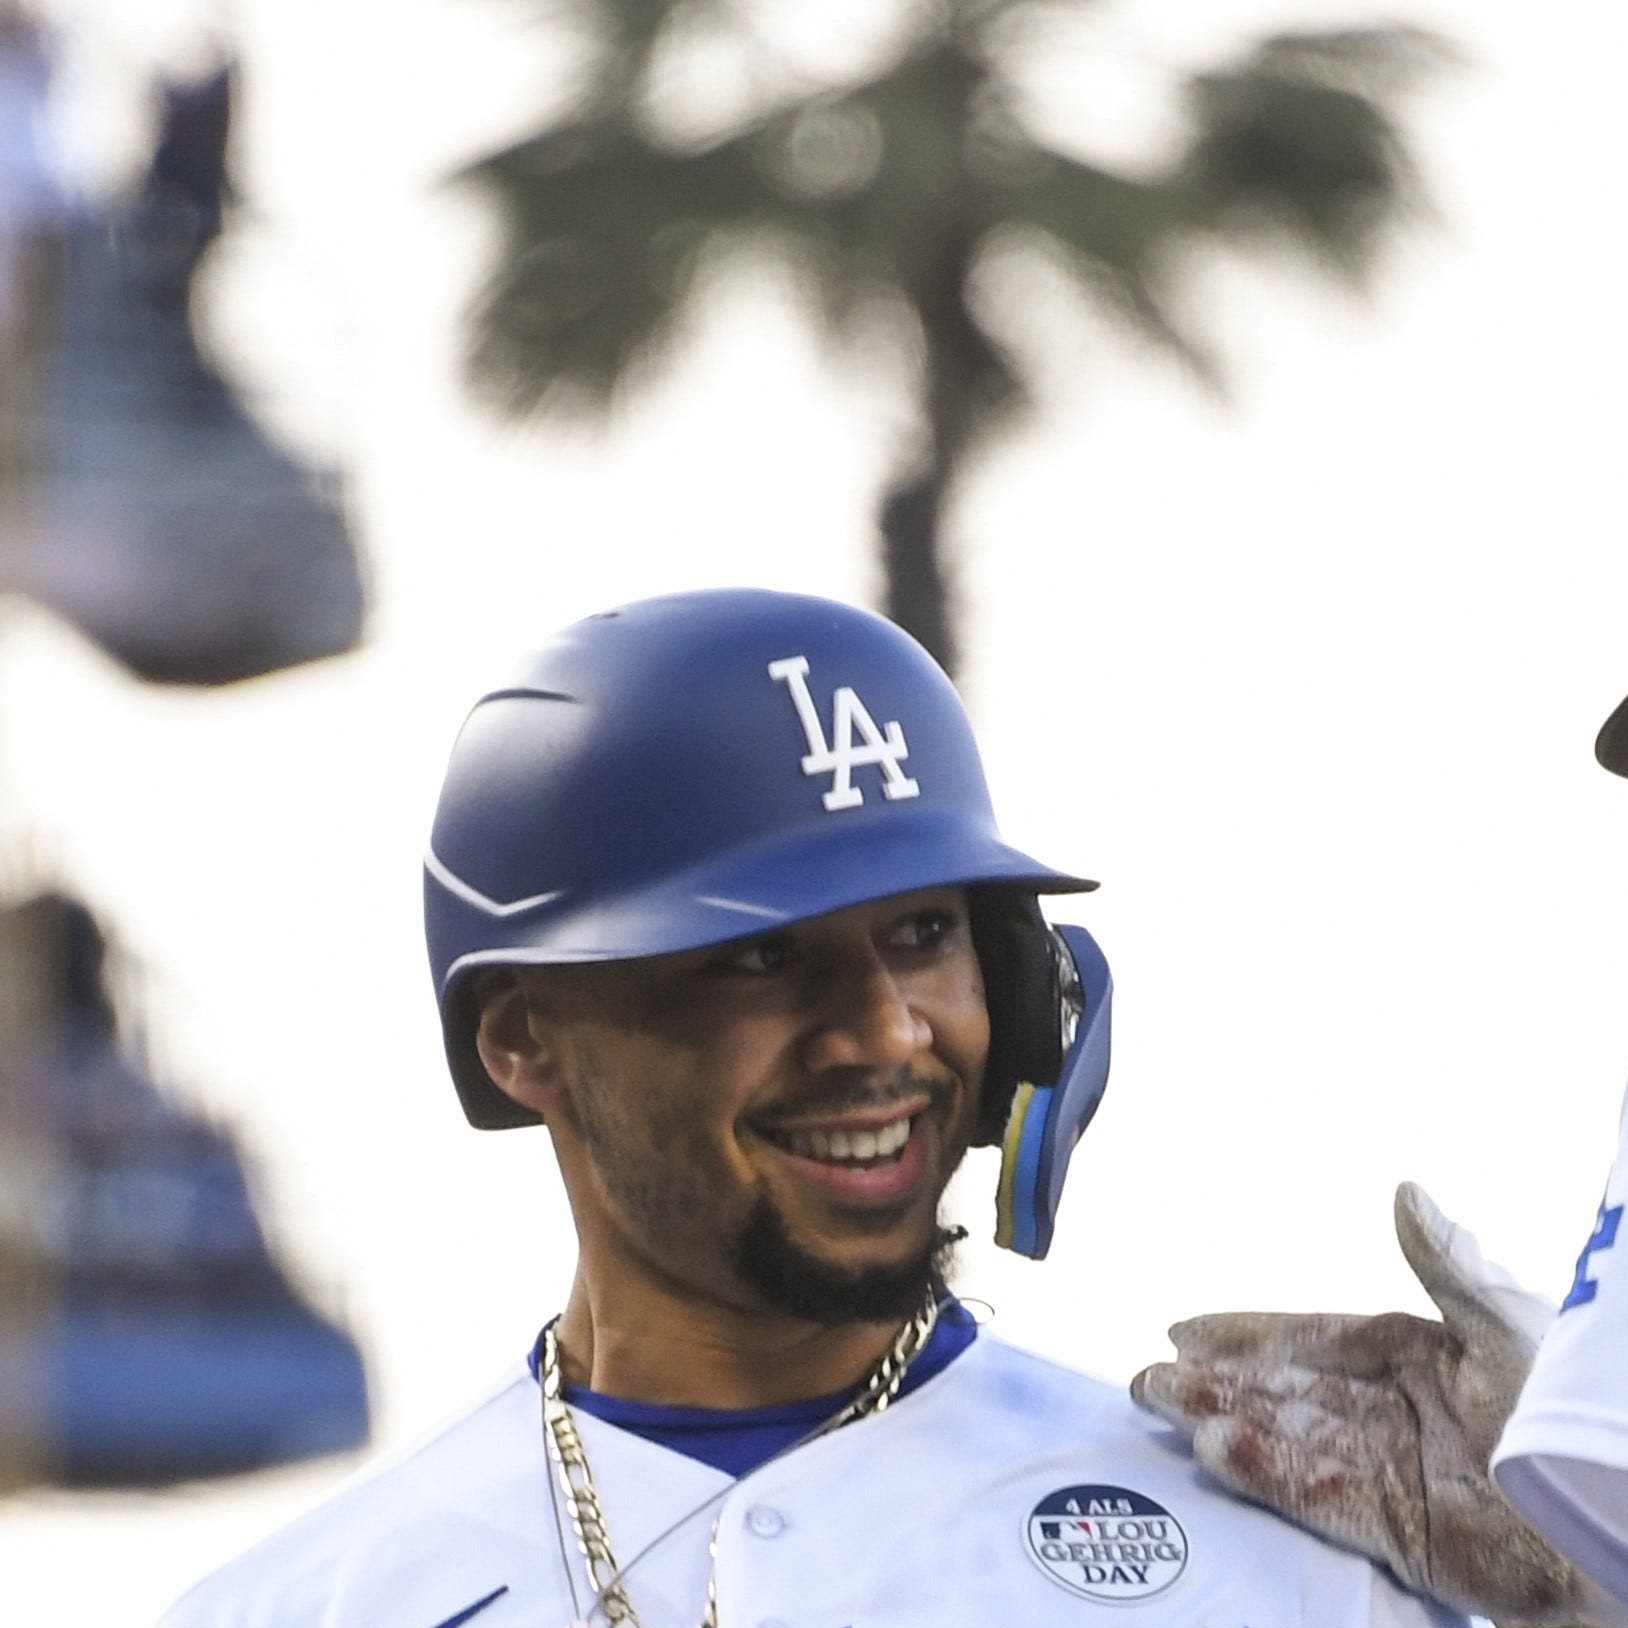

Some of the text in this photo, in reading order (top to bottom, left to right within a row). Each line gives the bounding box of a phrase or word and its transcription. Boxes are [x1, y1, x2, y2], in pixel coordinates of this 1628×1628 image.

[767, 654, 920, 812] LA
[1095, 1520, 1169, 1541] LOU
[1039, 1542, 1182, 1562] GEHRIG
[1082, 1564, 1150, 1585] DAY
